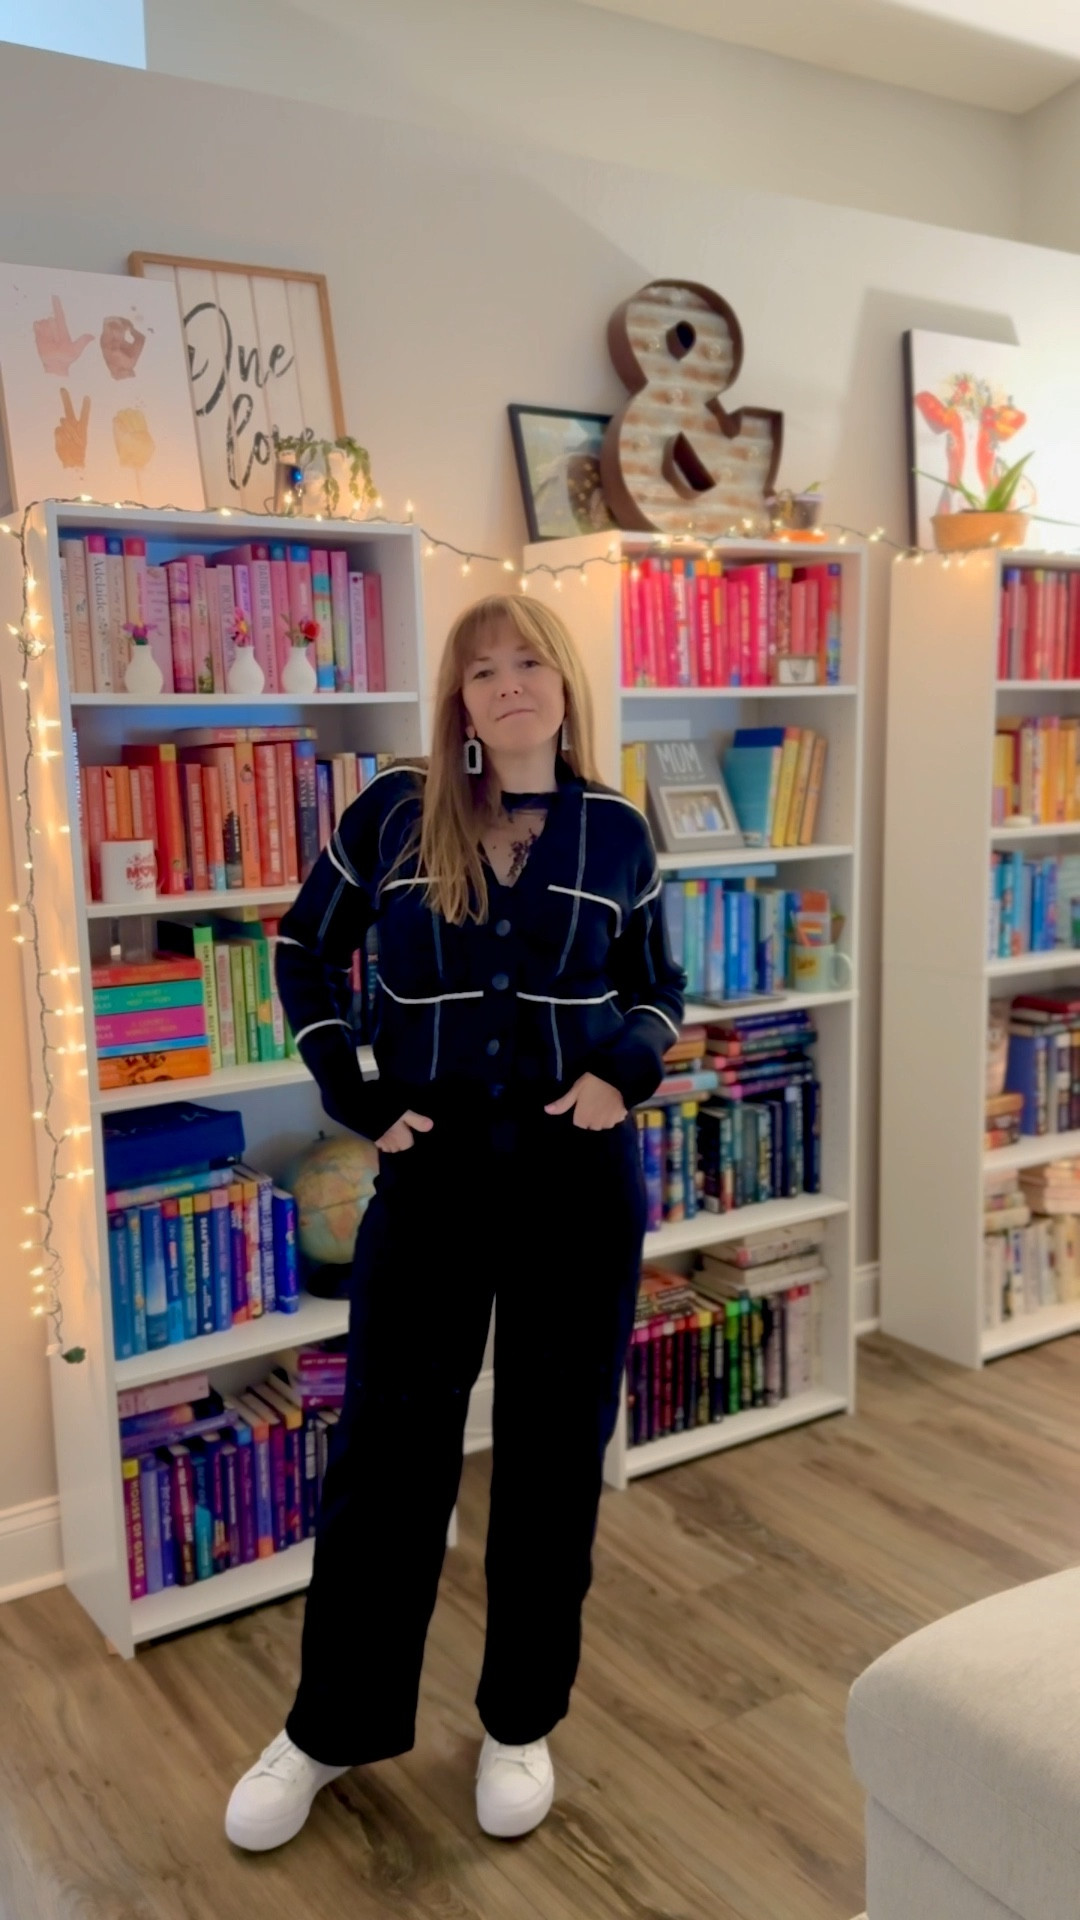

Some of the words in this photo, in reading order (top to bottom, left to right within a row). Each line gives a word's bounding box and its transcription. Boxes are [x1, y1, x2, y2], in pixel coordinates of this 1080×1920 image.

[184, 302, 295, 416] One
[93, 556, 107, 612] Adelaide
[258, 563, 268, 595] DATING
[655, 742, 704, 773] MOM
[131, 1480, 141, 1519] HOUSE
[133, 1521, 142, 1538] OF
[134, 1540, 144, 1577] GLASS
